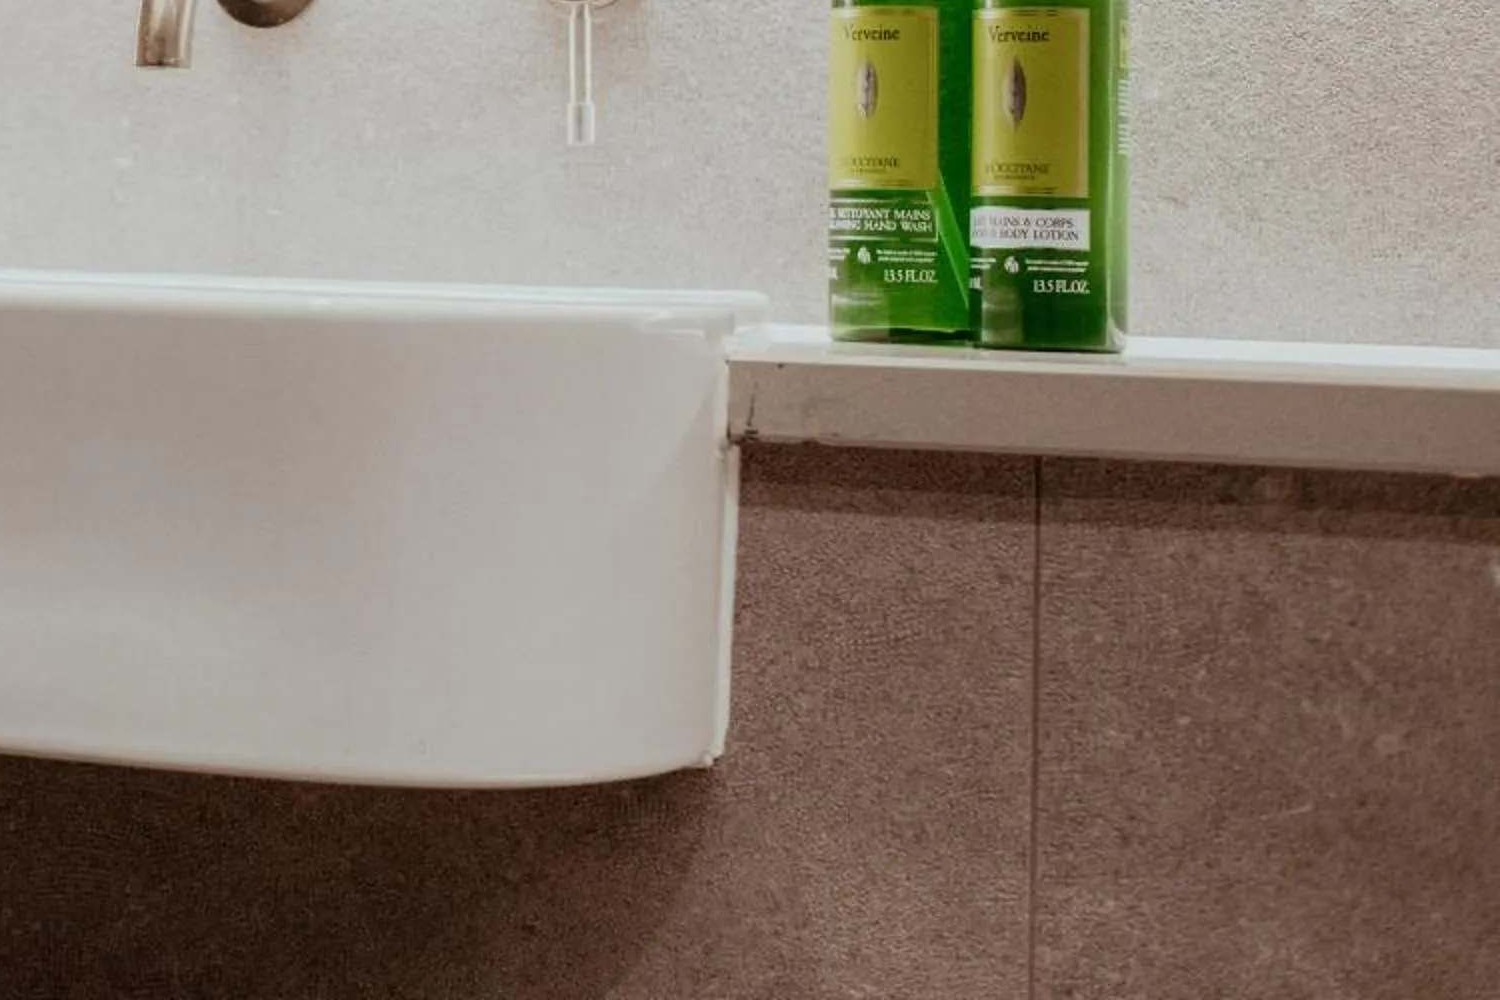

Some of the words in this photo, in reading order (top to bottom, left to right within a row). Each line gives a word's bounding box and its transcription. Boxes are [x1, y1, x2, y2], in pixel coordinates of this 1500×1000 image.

[987, 25, 1050, 43] Verveine
[893, 209, 931, 221] MAINS
[863, 220, 898, 232] HAND
[900, 221, 933, 233] WASH
[1033, 229, 1079, 241] LOTION
